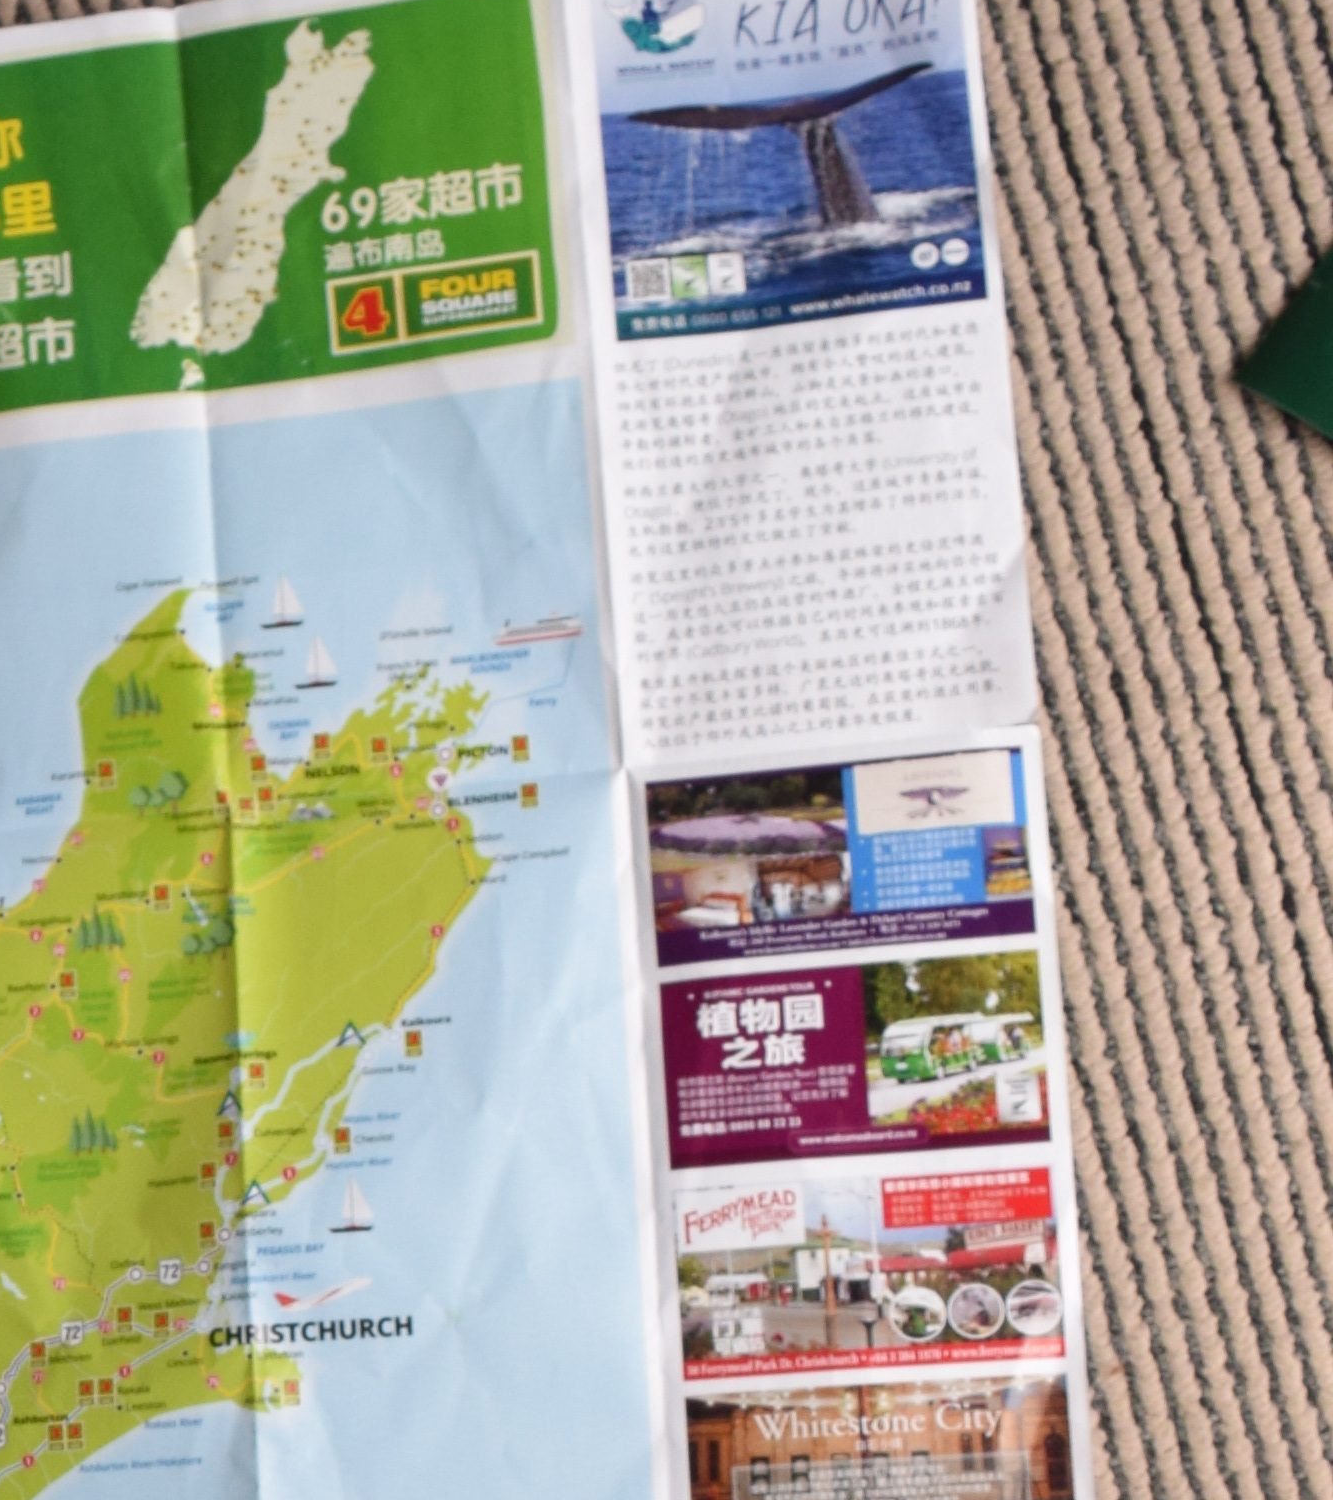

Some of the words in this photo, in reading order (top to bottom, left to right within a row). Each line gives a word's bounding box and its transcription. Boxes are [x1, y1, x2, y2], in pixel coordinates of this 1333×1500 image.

[321, 162, 522, 233] 69家超市
[420, 268, 516, 300] FOUR
[791, 279, 972, 317] www.whalewatch.co.nz
[342, 286, 390, 336] 4
[422, 288, 517, 316] SQUARE
[305, 764, 361, 780] NELSON
[696, 994, 824, 1038] 植物园
[721, 1034, 806, 1069] 之旅
[683, 1189, 796, 1245] FERRYMEAD
[161, 1263, 182, 1279] 72
[63, 1325, 82, 1341] 72
[208, 1315, 414, 1349] CHRISTCHURCH
[754, 1412, 927, 1441] Whitestone
[936, 1403, 1002, 1438] City
